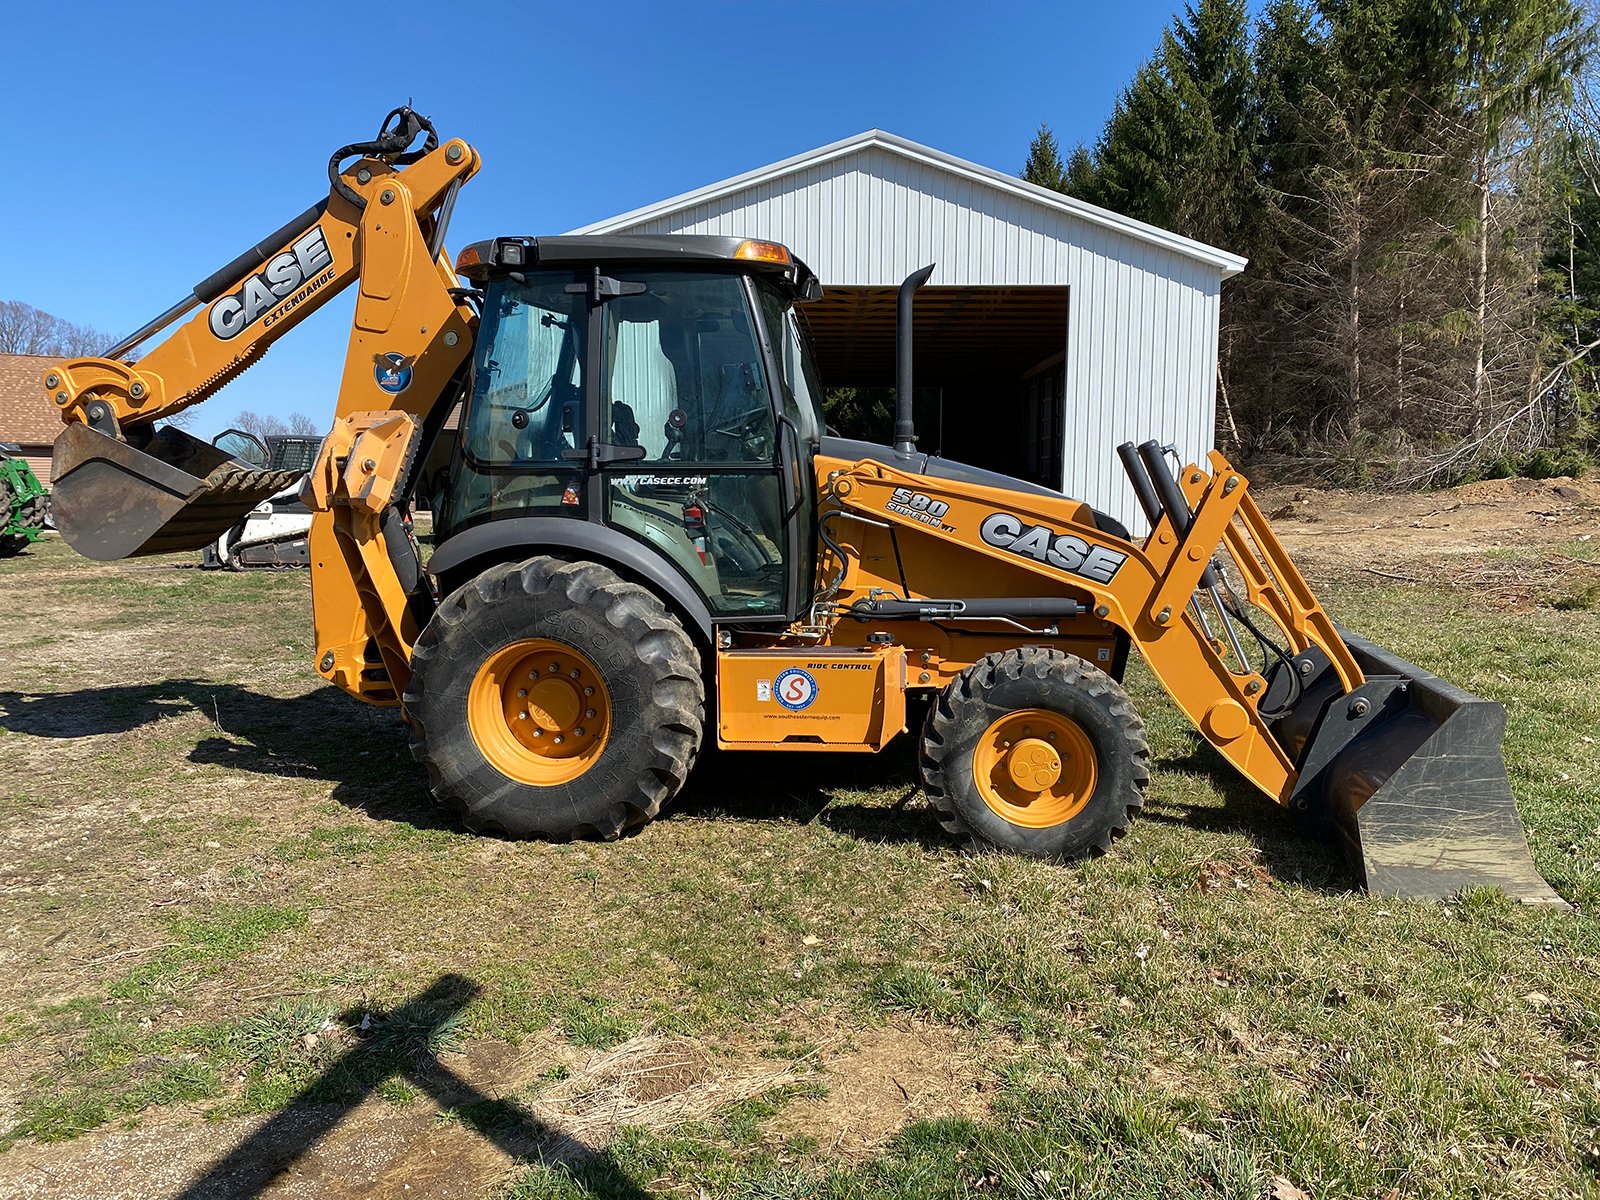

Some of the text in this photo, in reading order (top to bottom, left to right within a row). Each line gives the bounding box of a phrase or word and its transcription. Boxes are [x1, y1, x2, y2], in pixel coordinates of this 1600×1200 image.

[209, 226, 333, 340] CASE
[263, 268, 336, 328] EXTENDAHOE
[610, 477, 707, 485] WWW.CASECE.COM
[885, 502, 957, 533] SUPER N WT
[891, 486, 950, 518] 580
[980, 513, 1128, 584] CASE
[785, 677, 805, 701] S
